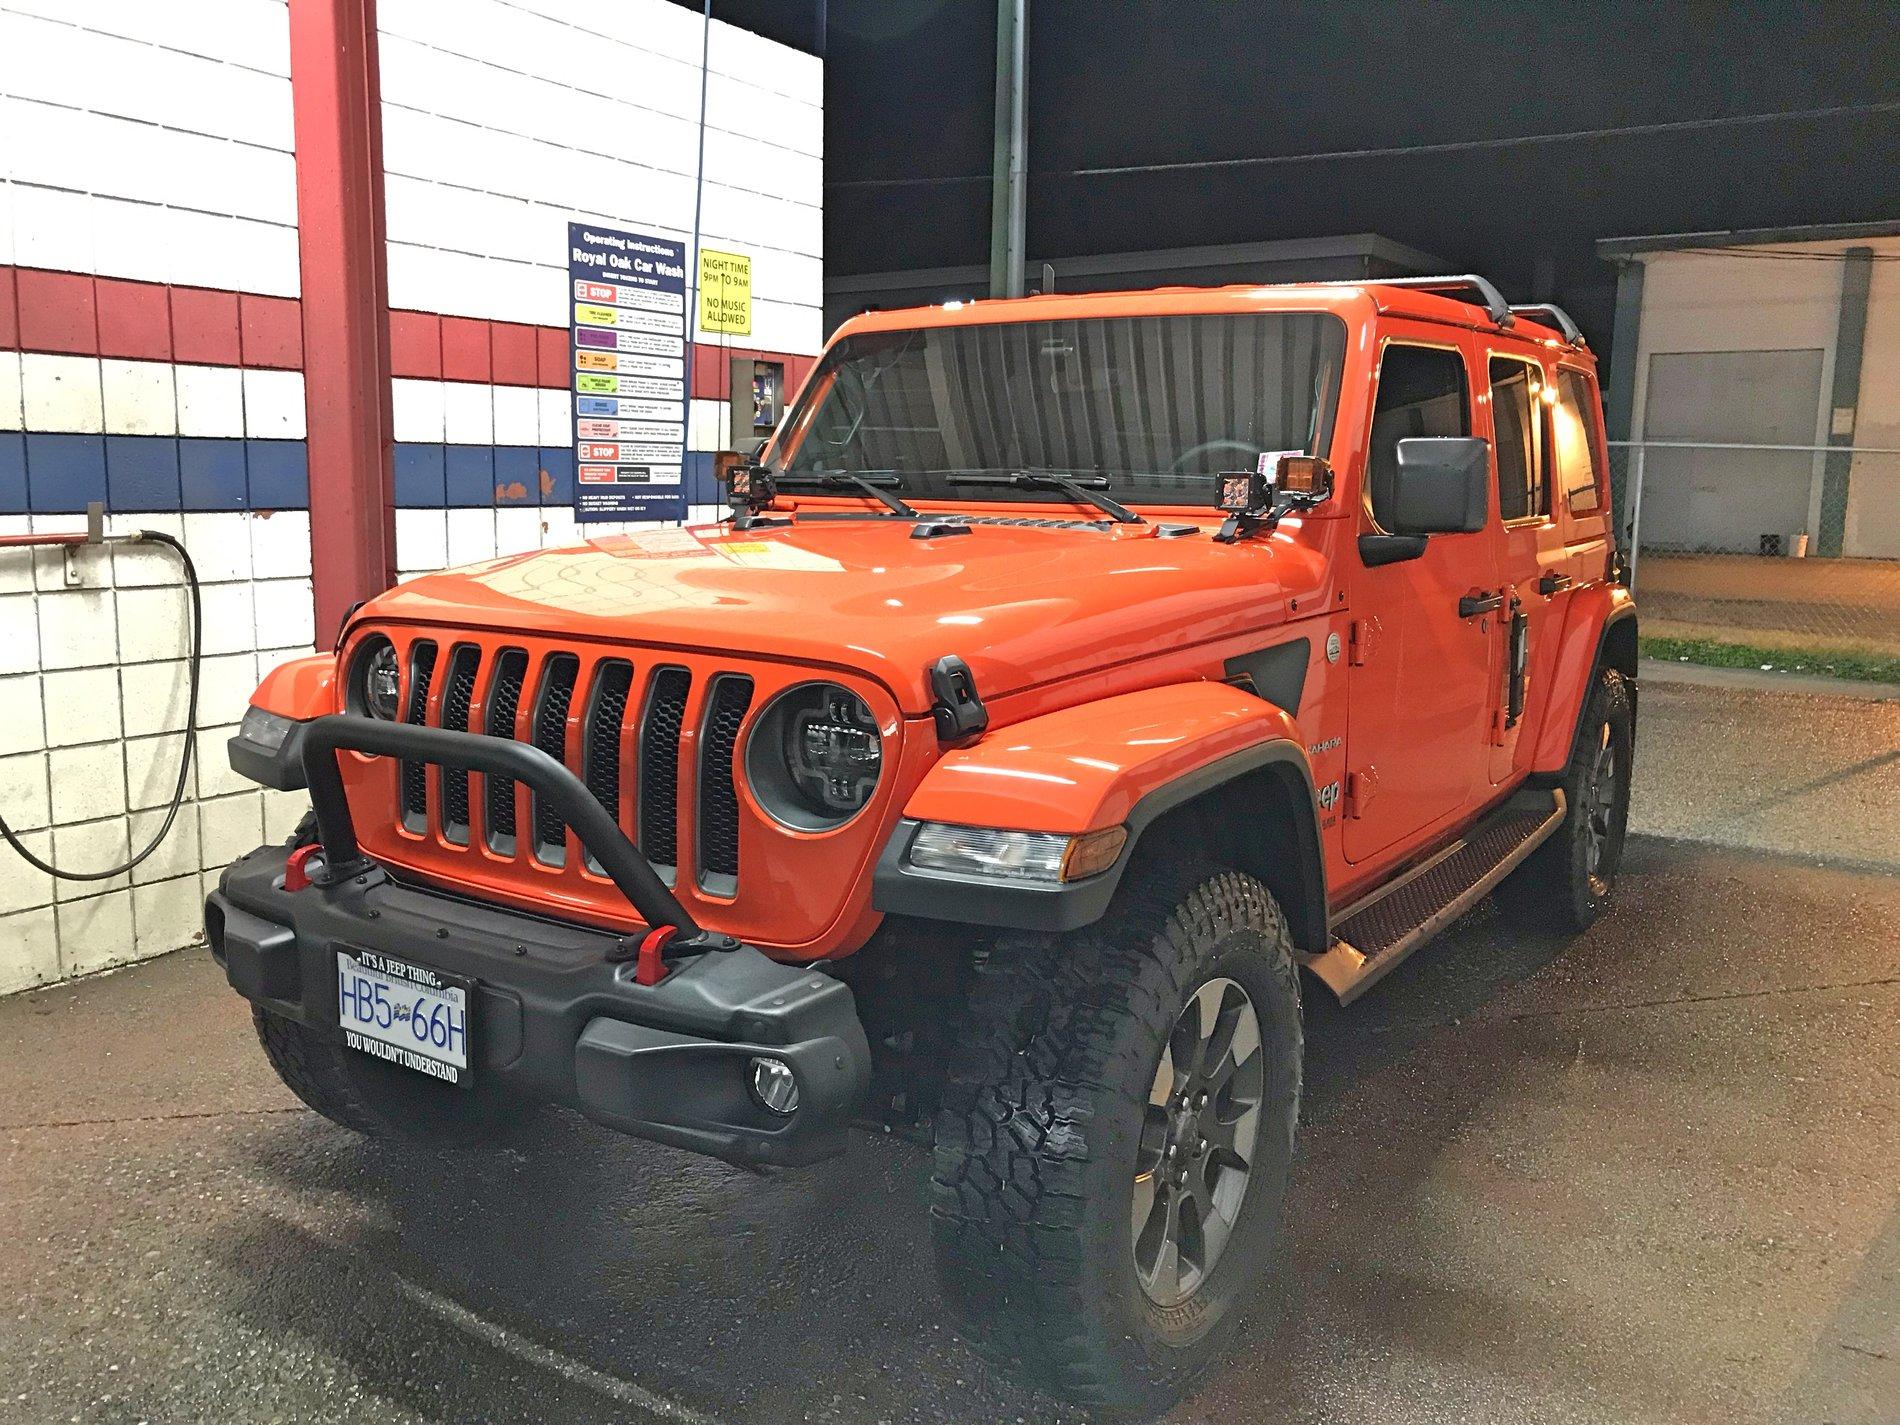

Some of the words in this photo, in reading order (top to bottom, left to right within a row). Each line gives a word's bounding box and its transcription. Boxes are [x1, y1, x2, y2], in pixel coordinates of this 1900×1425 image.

[583, 231, 626, 250] Operating
[626, 239, 675, 257] Instructions
[572, 247, 607, 267] Royal
[609, 253, 632, 270] Oak
[634, 258, 653, 273] Car
[655, 261, 684, 279] Wash
[703, 257, 728, 271] NIGHT
[730, 262, 749, 274] TIME
[703, 271, 719, 283] 9PM
[733, 276, 749, 287] 9AM
[589, 286, 613, 299] STOP
[706, 297, 719, 308] NO
[721, 299, 746, 312] MUSIC
[707, 310, 746, 325] ALLOWED
[592, 447, 615, 458] STOP
[361, 951, 378, 969] IT'S
[378, 956, 385, 971] A
[385, 958, 406, 977] JEEP
[406, 964, 436, 986] THING
[340, 971, 393, 1029] HB5
[411, 997, 466, 1056] 66H
[346, 1030, 362, 1050] YOU
[363, 1036, 404, 1065] WOULDN'T
[404, 1051, 458, 1084] UNDERSTAND
